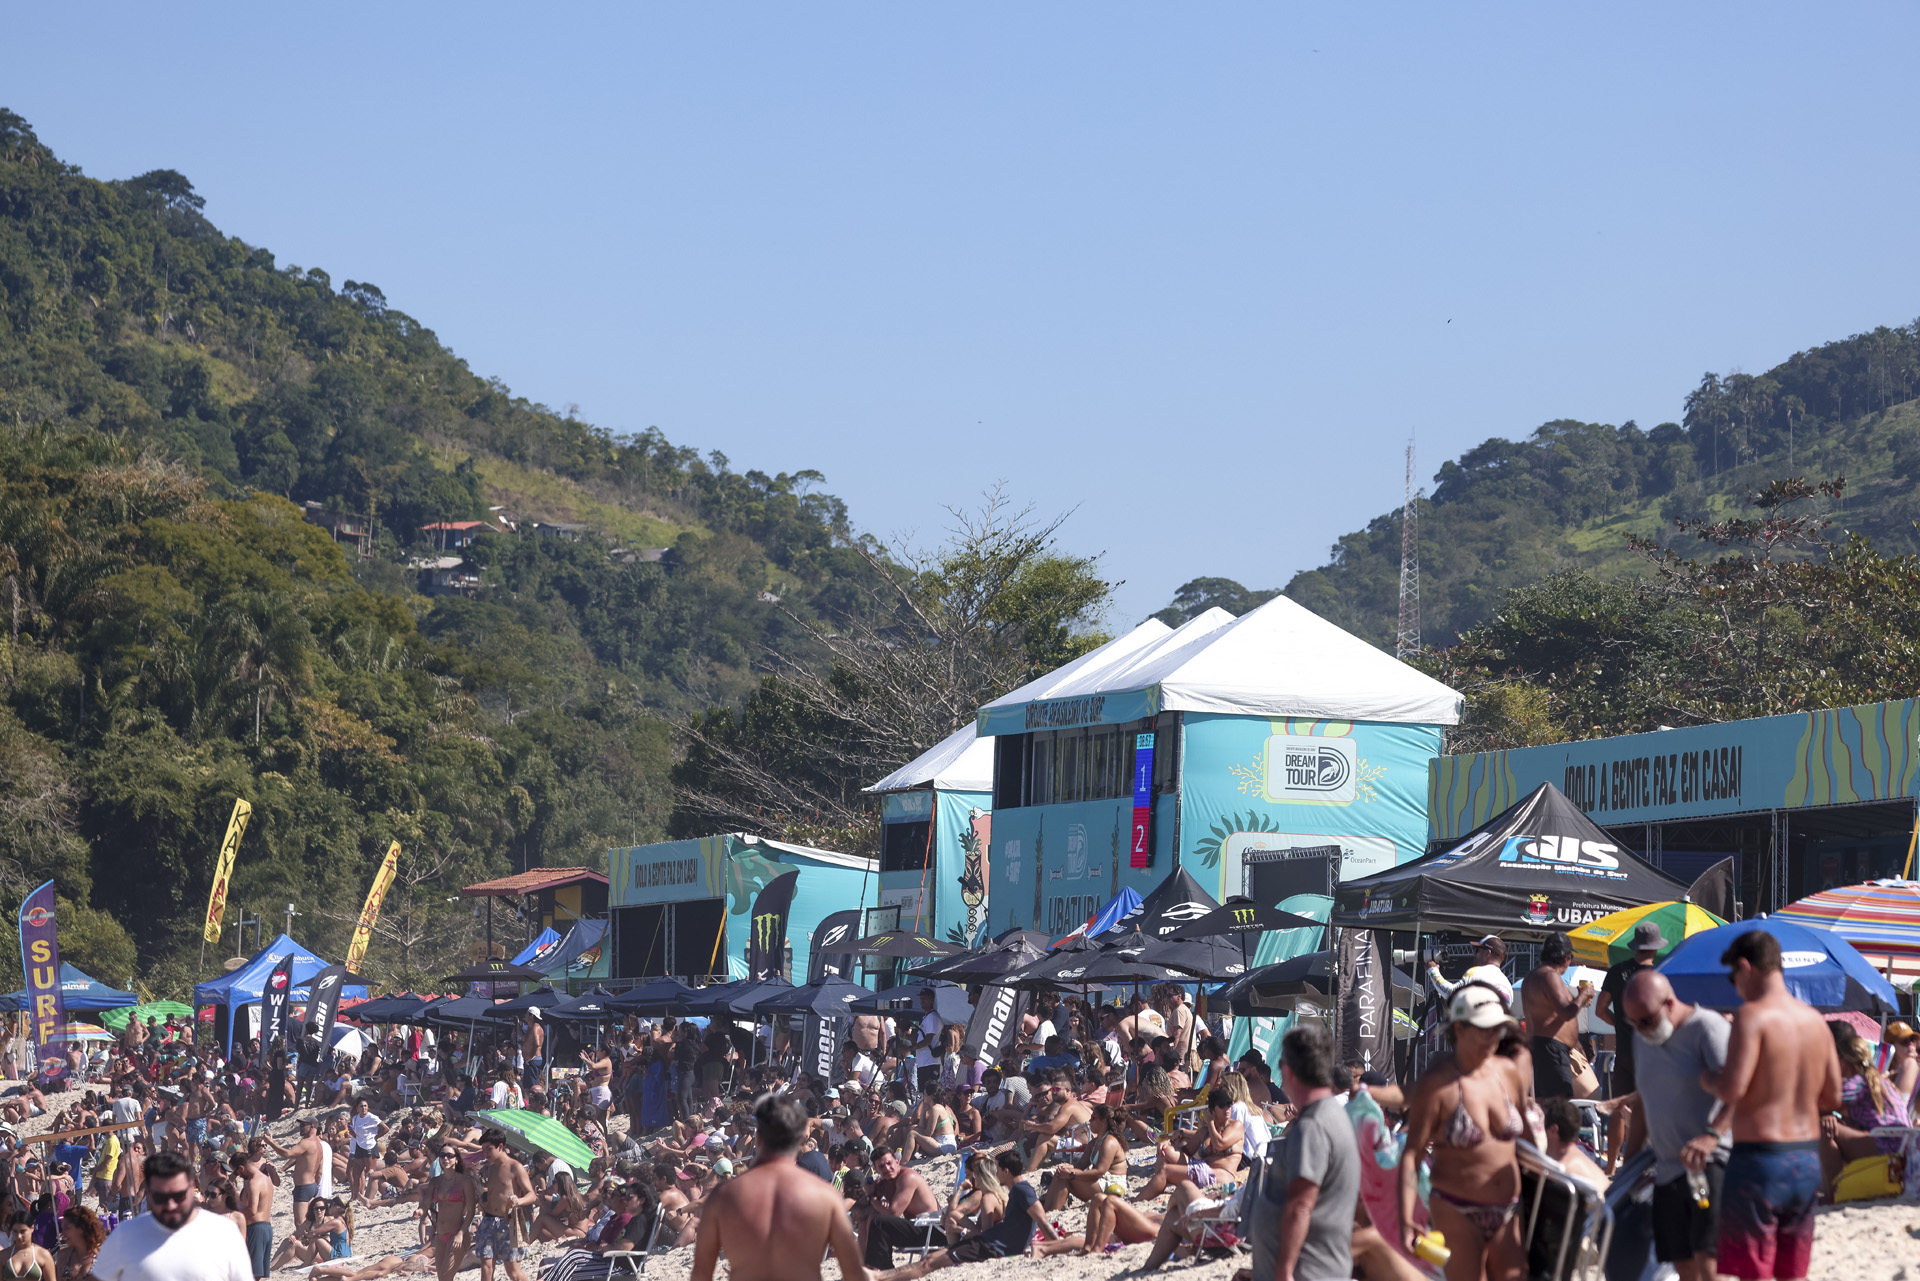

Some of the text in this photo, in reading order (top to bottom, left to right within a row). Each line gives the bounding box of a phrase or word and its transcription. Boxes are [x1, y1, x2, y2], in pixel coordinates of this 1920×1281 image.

[1285, 754, 1316, 768] DREAM
[1139, 764, 1146, 792] 1
[1286, 768, 1316, 786] TOUR
[1599, 762, 1608, 812] A
[1611, 757, 1649, 811] GENTE
[1653, 753, 1677, 807] FAZ
[1681, 750, 1699, 803] EM
[1702, 745, 1742, 807] CASA!
[1135, 824, 1145, 853] 2
[208, 805, 251, 927] KAYAK
[1350, 856, 1377, 864] OceanPact
[1606, 871, 1629, 879] Surf
[1572, 901, 1600, 909] Prefeitura
[31, 939, 58, 1045] SURF
[1354, 928, 1376, 1039] PARAFINA
